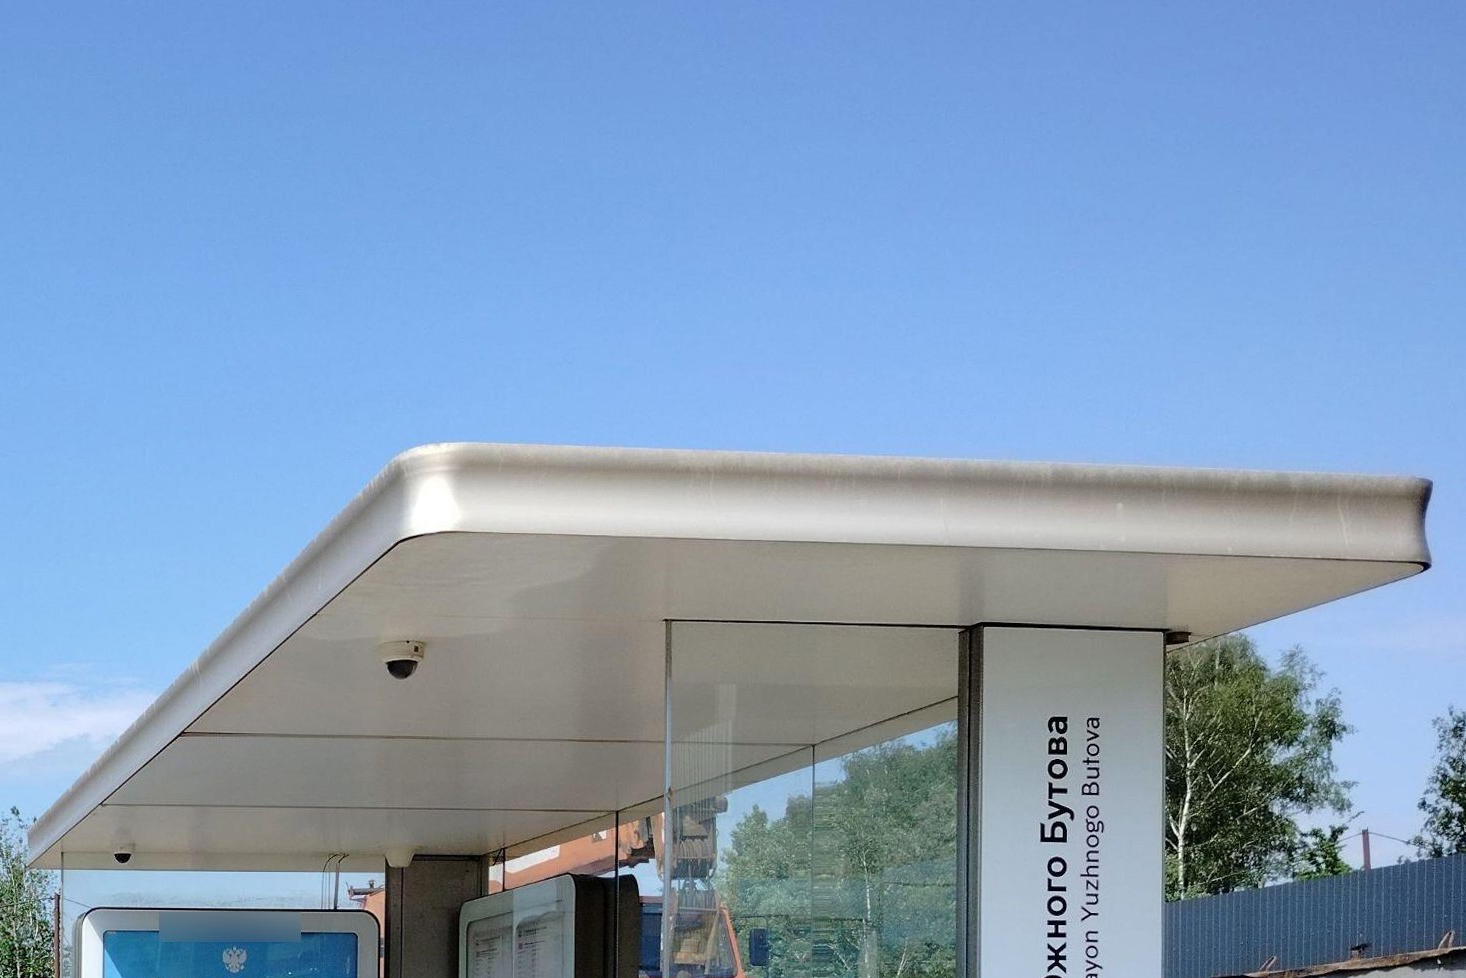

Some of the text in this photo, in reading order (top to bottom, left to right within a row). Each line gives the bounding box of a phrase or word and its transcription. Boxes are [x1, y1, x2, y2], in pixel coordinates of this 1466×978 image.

[1039, 716, 1075, 844] Бутова
[1081, 717, 1101, 796] Butova
[1080, 805, 1104, 922] Yuzhnogo
